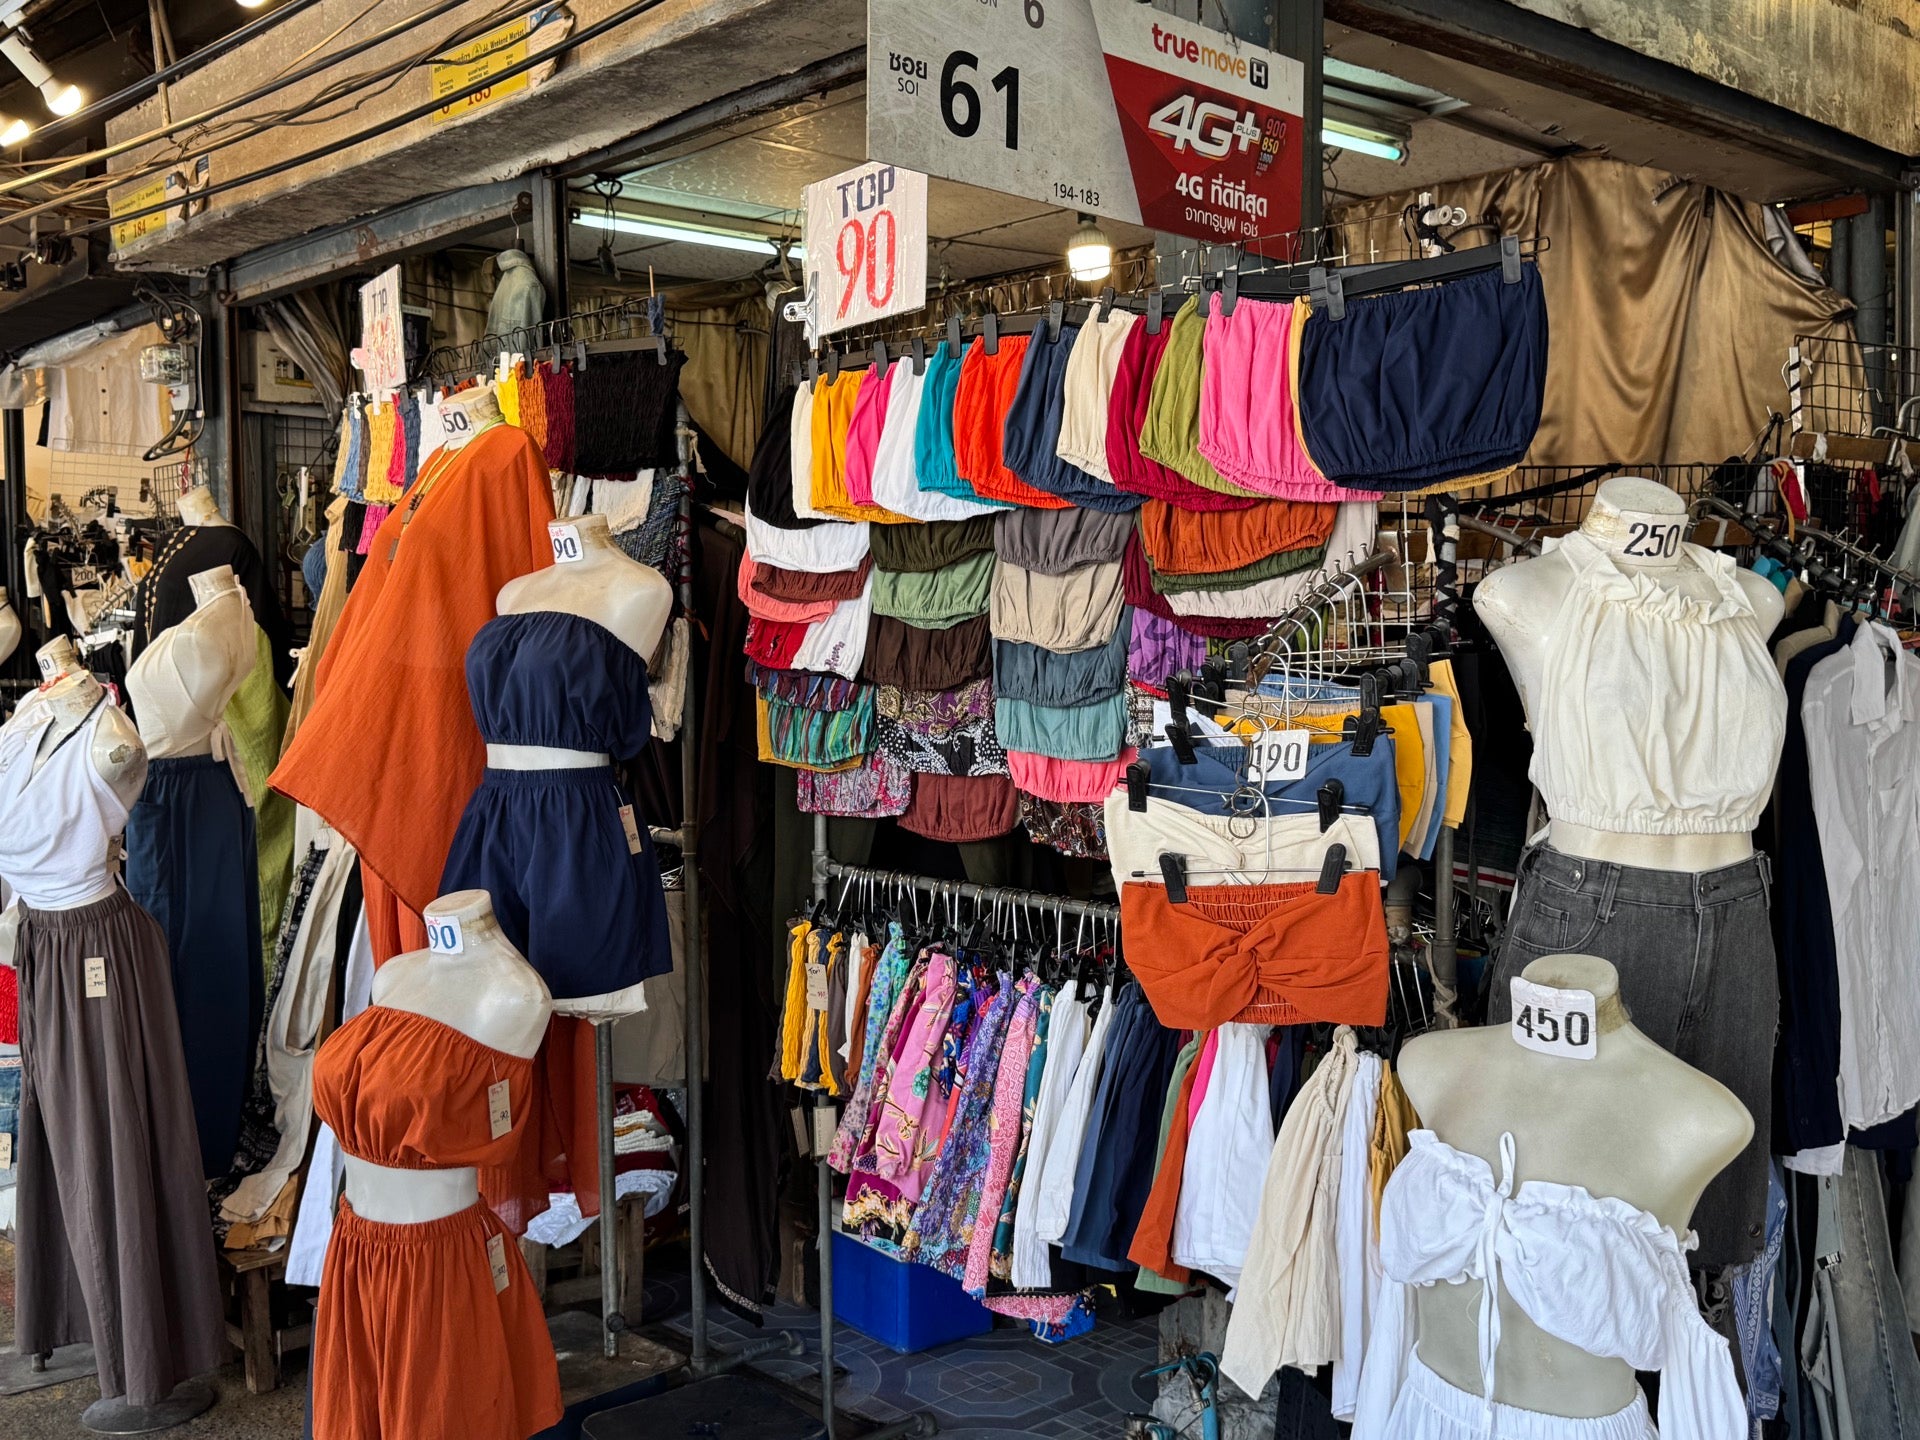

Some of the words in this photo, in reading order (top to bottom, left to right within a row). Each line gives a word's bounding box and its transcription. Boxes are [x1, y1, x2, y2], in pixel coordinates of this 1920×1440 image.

[1024, 0, 1045, 28] 6
[889, 51, 927, 79] ซอย
[1251, 59, 1267, 88] H
[898, 77, 919, 96] SOI
[940, 50, 1019, 151] 61
[1236, 124, 1258, 138] PLUS
[1266, 118, 1287, 139] 900
[1261, 138, 1280, 154] 850
[837, 166, 895, 218] TOP
[1053, 182, 1100, 206] 194-183
[1175, 172, 1203, 200] 4G
[1211, 173, 1268, 222] ที่ดีที่สุด
[120, 228, 126, 244] 6
[133, 219, 147, 239] 184
[1185, 207, 1237, 234] จากทรูมูฟ
[1240, 222, 1259, 237] เอช
[836, 209, 896, 320] 90
[553, 537, 577, 559] 90
[1623, 522, 1680, 558] 250
[74, 570, 94, 582] 200
[1254, 743, 1302, 773] 190
[428, 924, 457, 949] 90
[1516, 1004, 1590, 1047] 450
